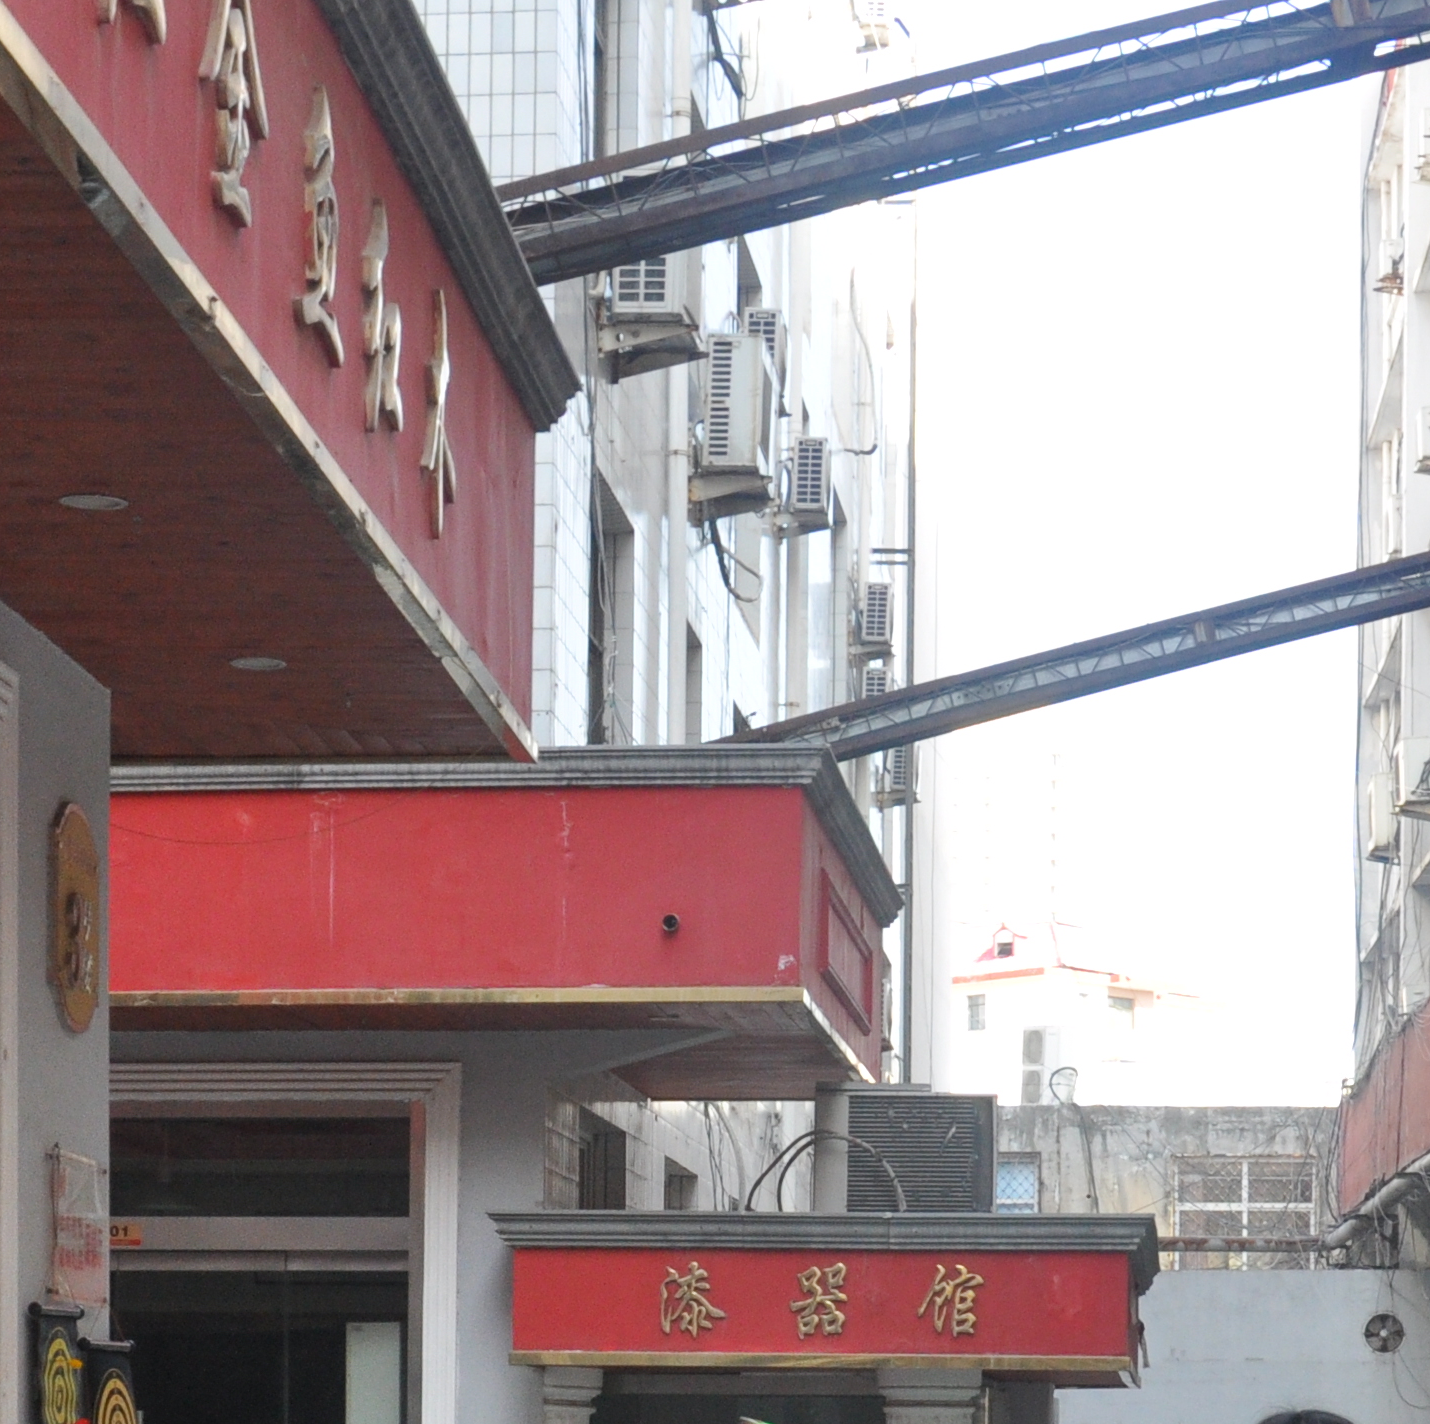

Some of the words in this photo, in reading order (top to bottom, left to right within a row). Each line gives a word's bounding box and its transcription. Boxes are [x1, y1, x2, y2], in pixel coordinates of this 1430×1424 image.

[97, 0, 458, 540] 金鱼红木
[660, 1260, 984, 1340] 漆器馆
